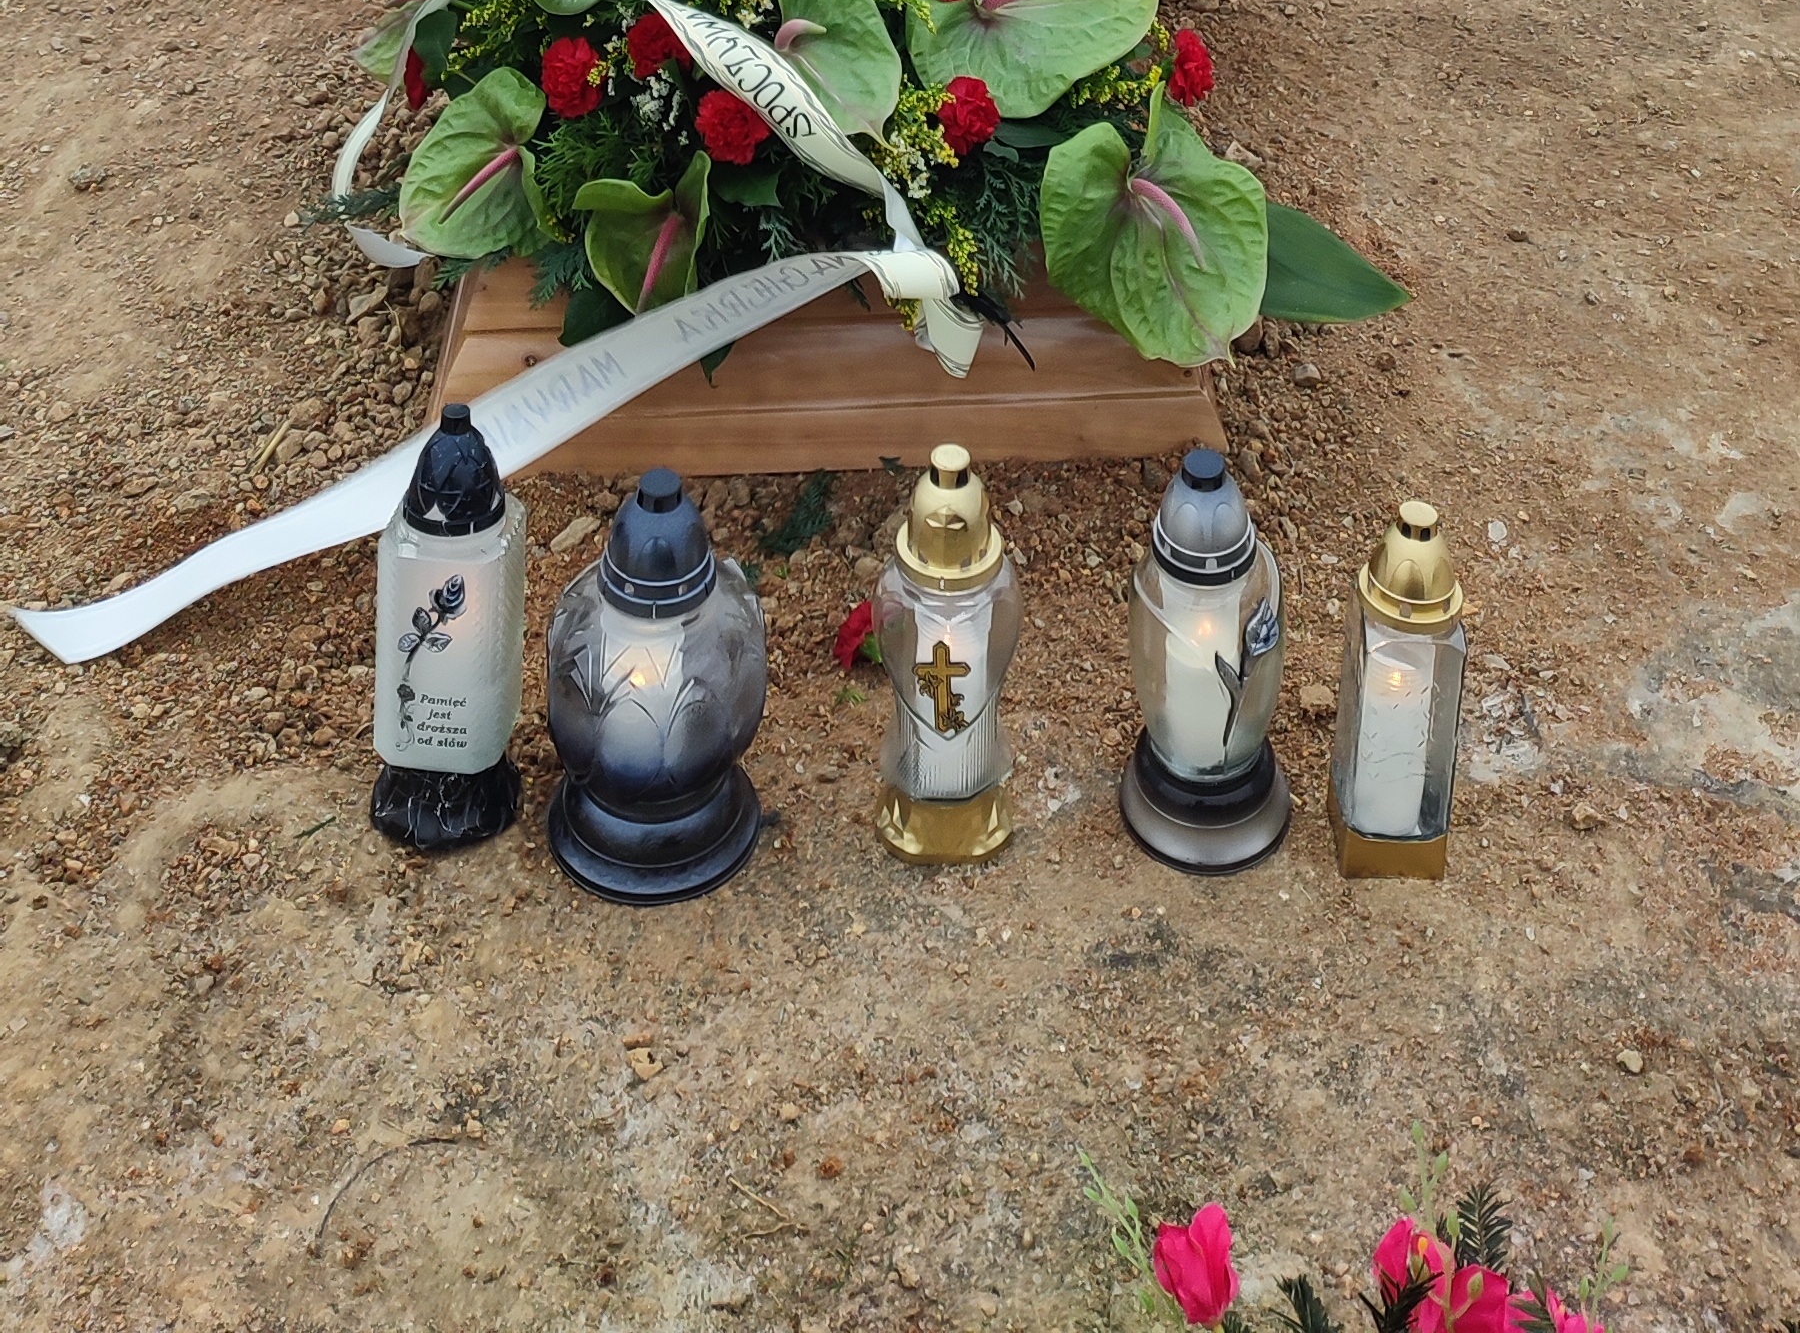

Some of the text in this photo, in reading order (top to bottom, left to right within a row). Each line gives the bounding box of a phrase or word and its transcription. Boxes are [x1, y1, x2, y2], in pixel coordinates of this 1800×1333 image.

[419, 693, 467, 709] Pamięć
[426, 708, 453, 721] jest
[416, 721, 468, 735] droższa
[417, 736, 434, 746] od
